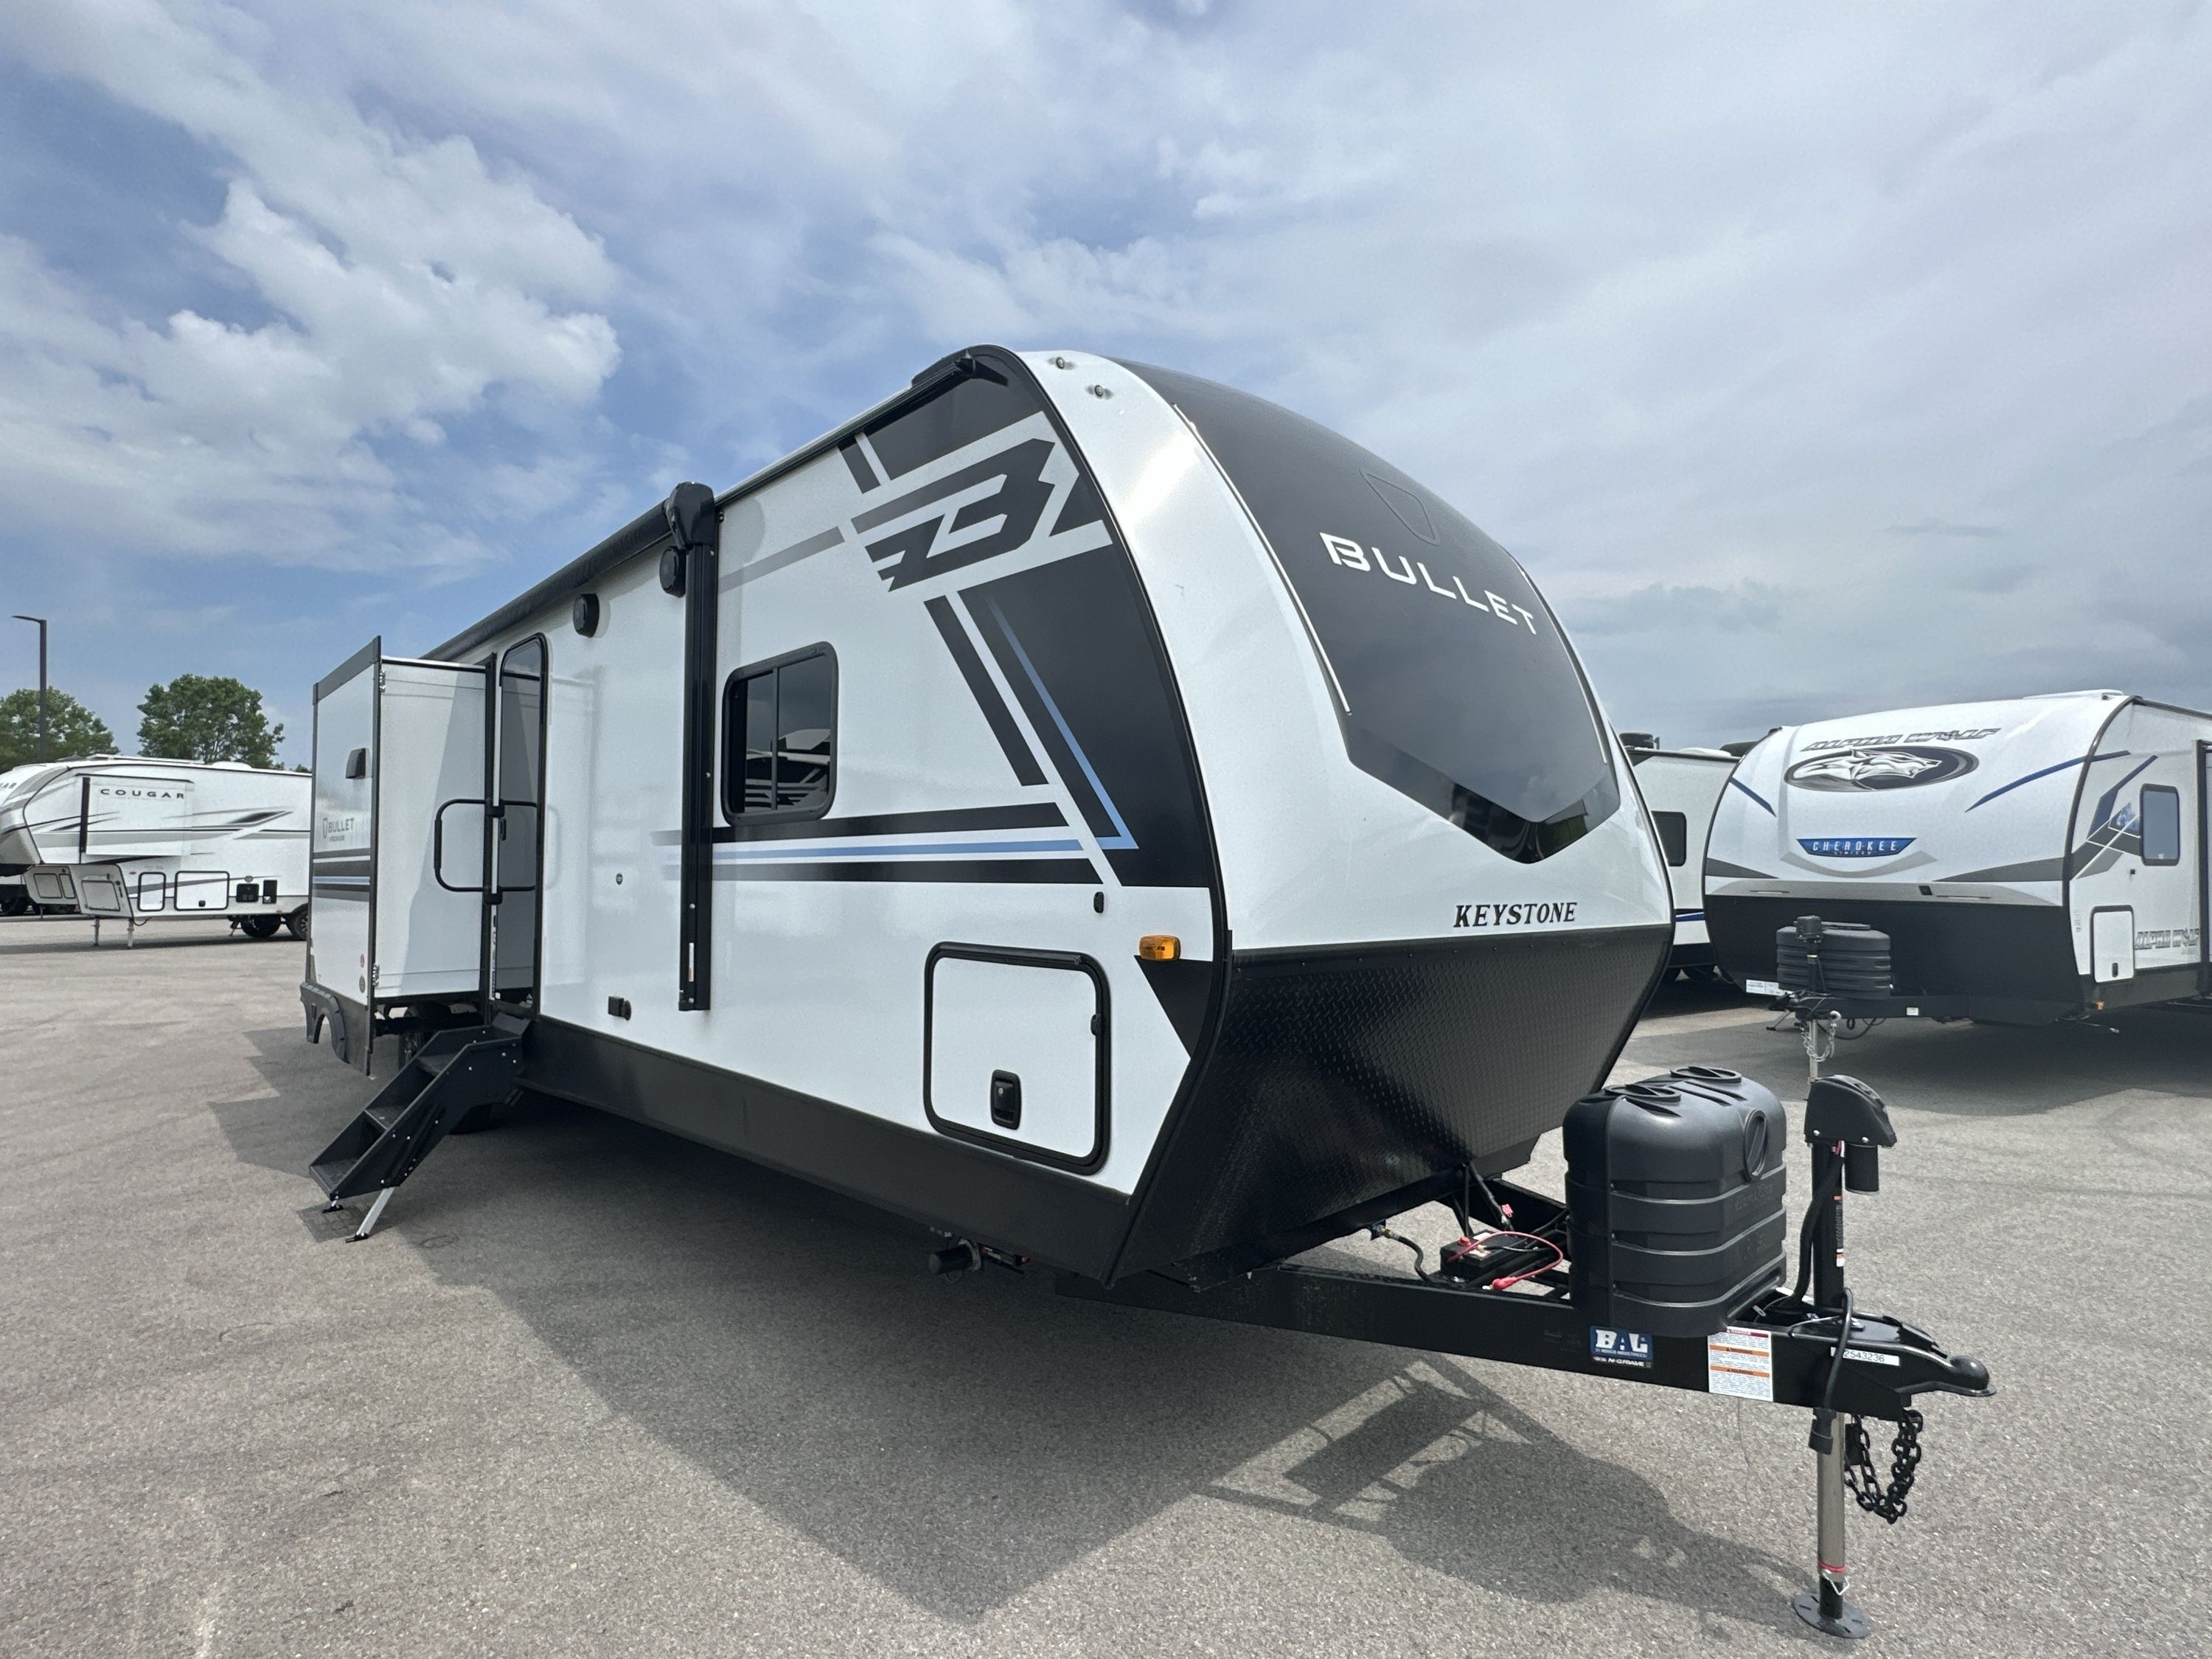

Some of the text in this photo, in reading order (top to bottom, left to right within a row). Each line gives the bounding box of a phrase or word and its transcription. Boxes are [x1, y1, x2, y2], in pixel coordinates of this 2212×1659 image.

[1320, 532, 1536, 635] BULLET
[100, 789, 184, 799] COUGAR
[328, 818, 354, 833] BULLET
[1812, 841, 1896, 851] CHEROKEE
[1453, 902, 1578, 928] KEYSTONE
[1844, 1350, 1885, 1363] 2543236
